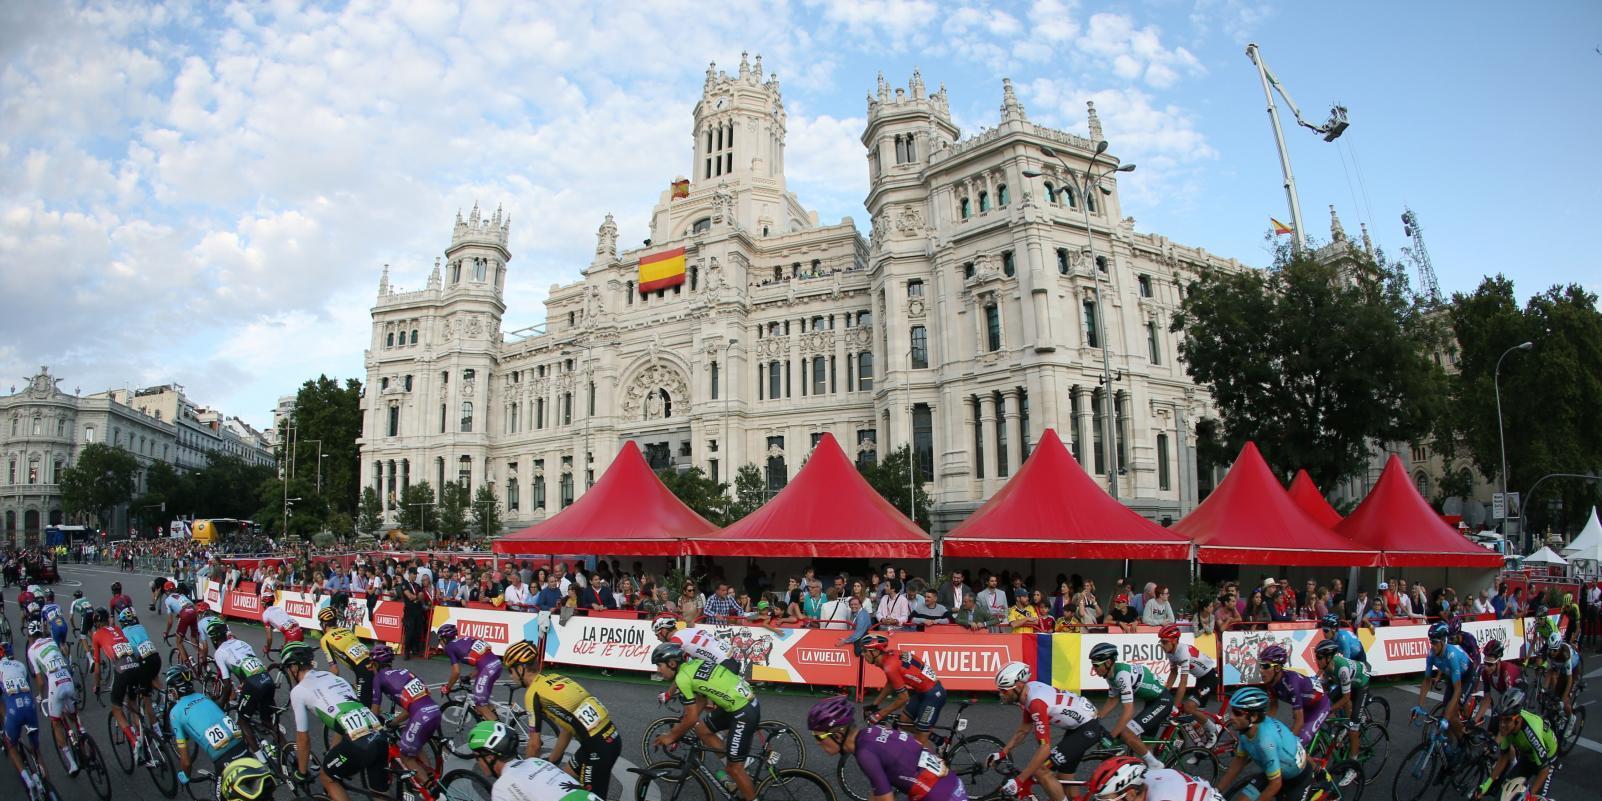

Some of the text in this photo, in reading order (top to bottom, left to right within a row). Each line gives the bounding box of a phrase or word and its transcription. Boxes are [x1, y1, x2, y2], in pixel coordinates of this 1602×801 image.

[233, 595, 258, 609] LA VUELTA
[286, 602, 312, 616] LA VUELTA
[1152, 608, 1166, 616] FILA
[382, 617, 398, 626] VUELTA
[460, 623, 505, 640] LA VUELTA
[583, 625, 645, 647] LA PASIÓN
[1476, 624, 1507, 643] LA PASIÓN
[573, 640, 651, 664] QUE TE TOCA
[802, 650, 846, 663] LA VUELTA
[1123, 640, 1168, 661] PASIÓ
[1389, 639, 1428, 657] LA VUELTA
[934, 651, 1001, 672] VUELTA
[5, 680, 15, 691] 84
[407, 680, 424, 696] 188
[698, 685, 736, 706] ORBEA
[344, 713, 363, 731] 117
[578, 705, 599, 726] 134
[1031, 712, 1046, 734] lotto
[209, 727, 225, 744] 26
[1523, 725, 1547, 759] MURIAS
[584, 765, 593, 783] VISMA
